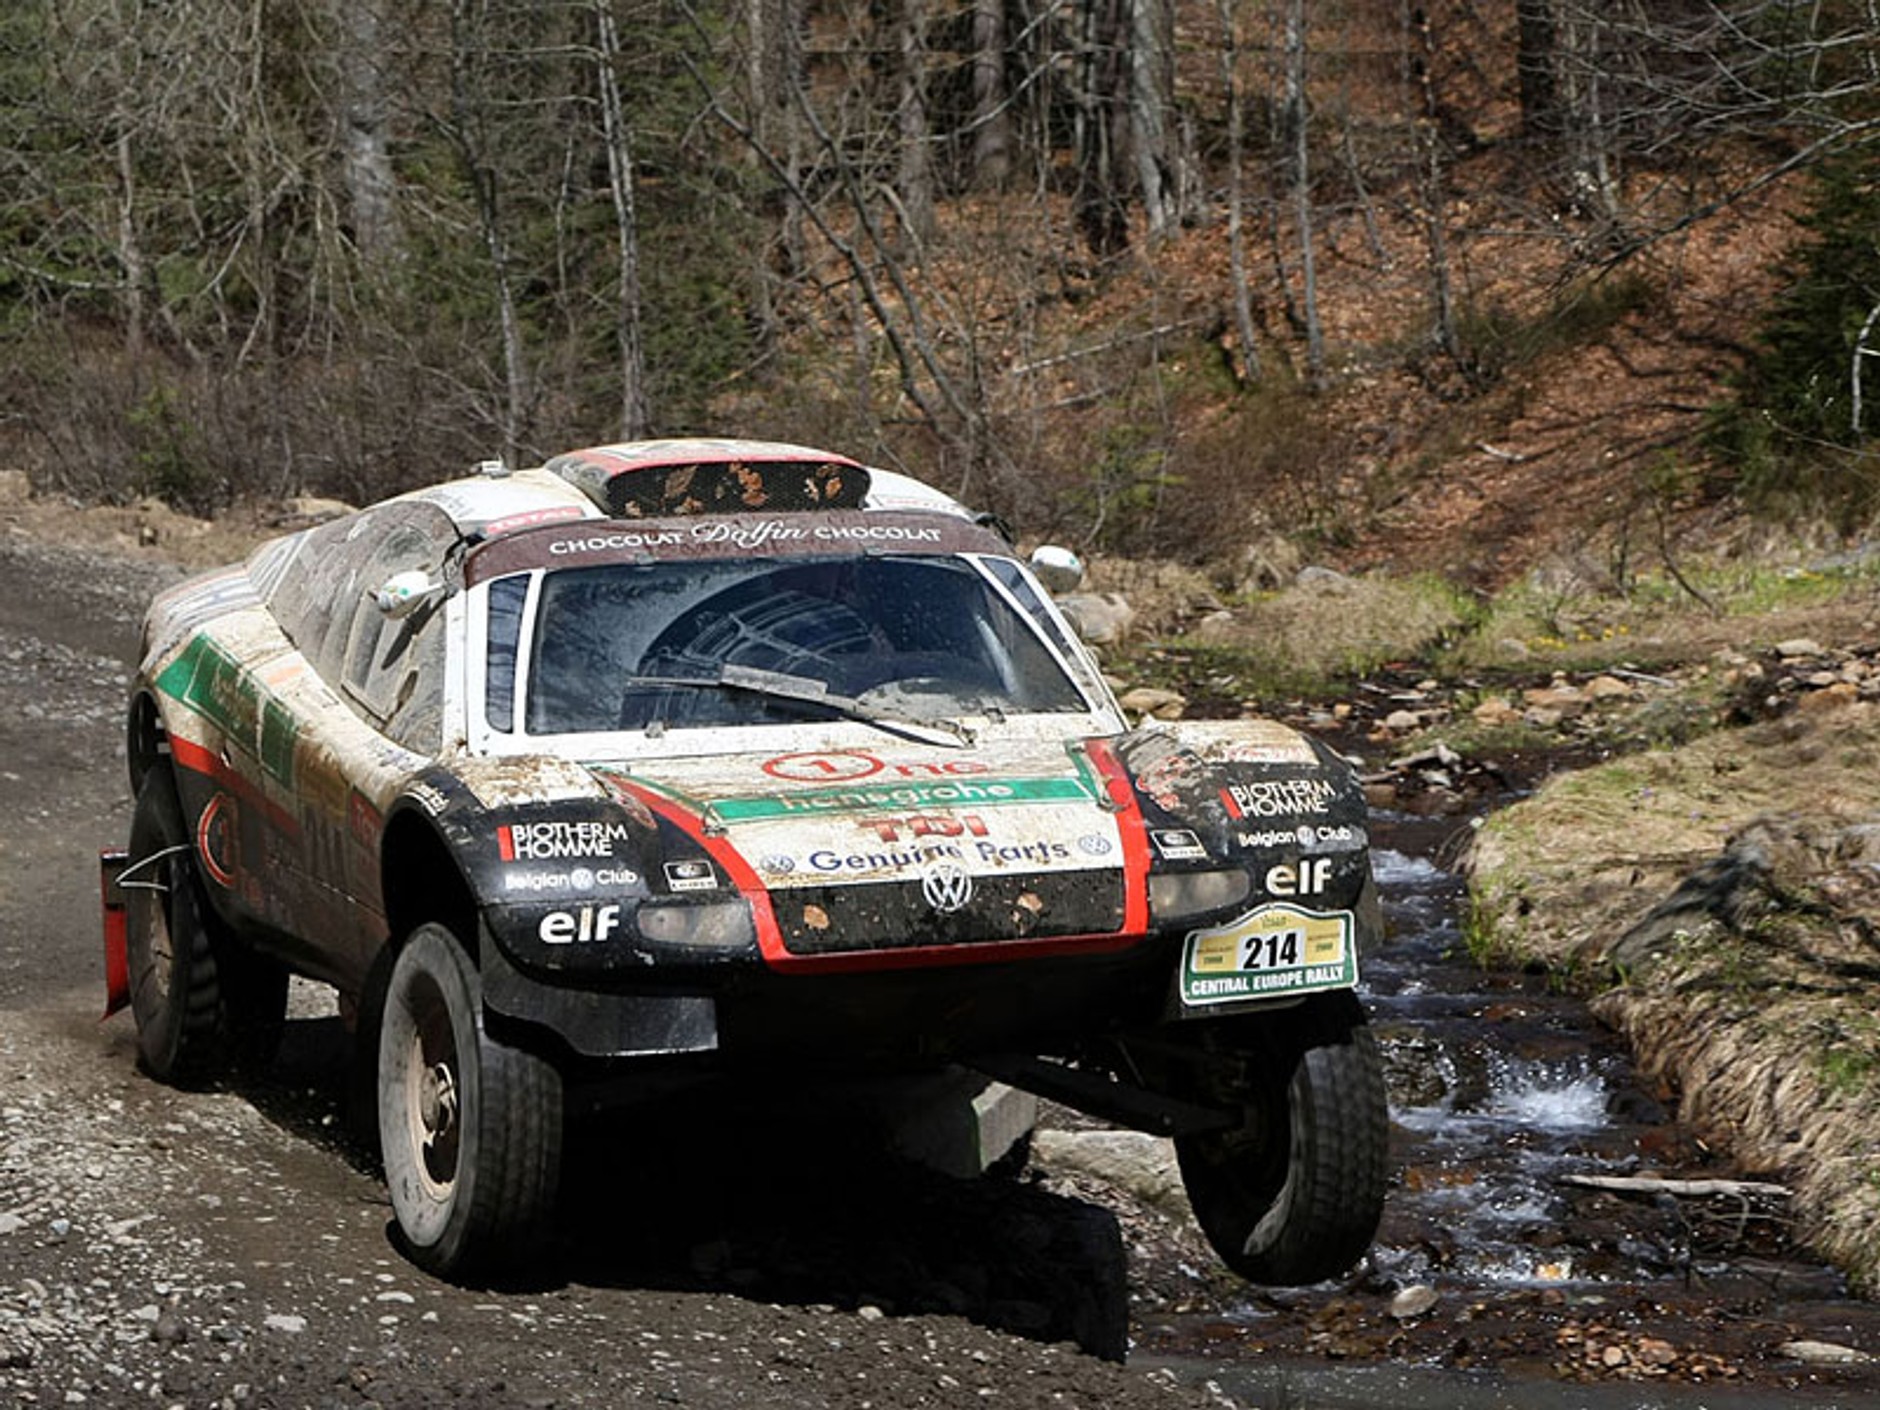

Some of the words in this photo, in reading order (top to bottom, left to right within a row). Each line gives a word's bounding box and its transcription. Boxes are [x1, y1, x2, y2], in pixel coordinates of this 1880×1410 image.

[549, 532, 683, 554] CHOCOLAT
[814, 526, 942, 542] CHOCOLAT
[1229, 780, 1336, 802] BIOTHERM
[1240, 798, 1329, 817] HOMME
[512, 822, 628, 842] BIOTHERM
[859, 815, 989, 843] TDI
[1238, 830, 1296, 847] Belgian
[1317, 827, 1352, 841] Club
[514, 839, 613, 859] HOMME
[976, 841, 1070, 862] Parts
[505, 872, 570, 891] Belgian
[597, 869, 638, 885] Club
[1266, 858, 1332, 896] elf
[539, 905, 620, 944] elf
[1243, 932, 1298, 970] 214
[1191, 978, 1250, 996] CENTRAL
[1253, 971, 1303, 990] EUROPE
[1306, 965, 1345, 983] RALLY
